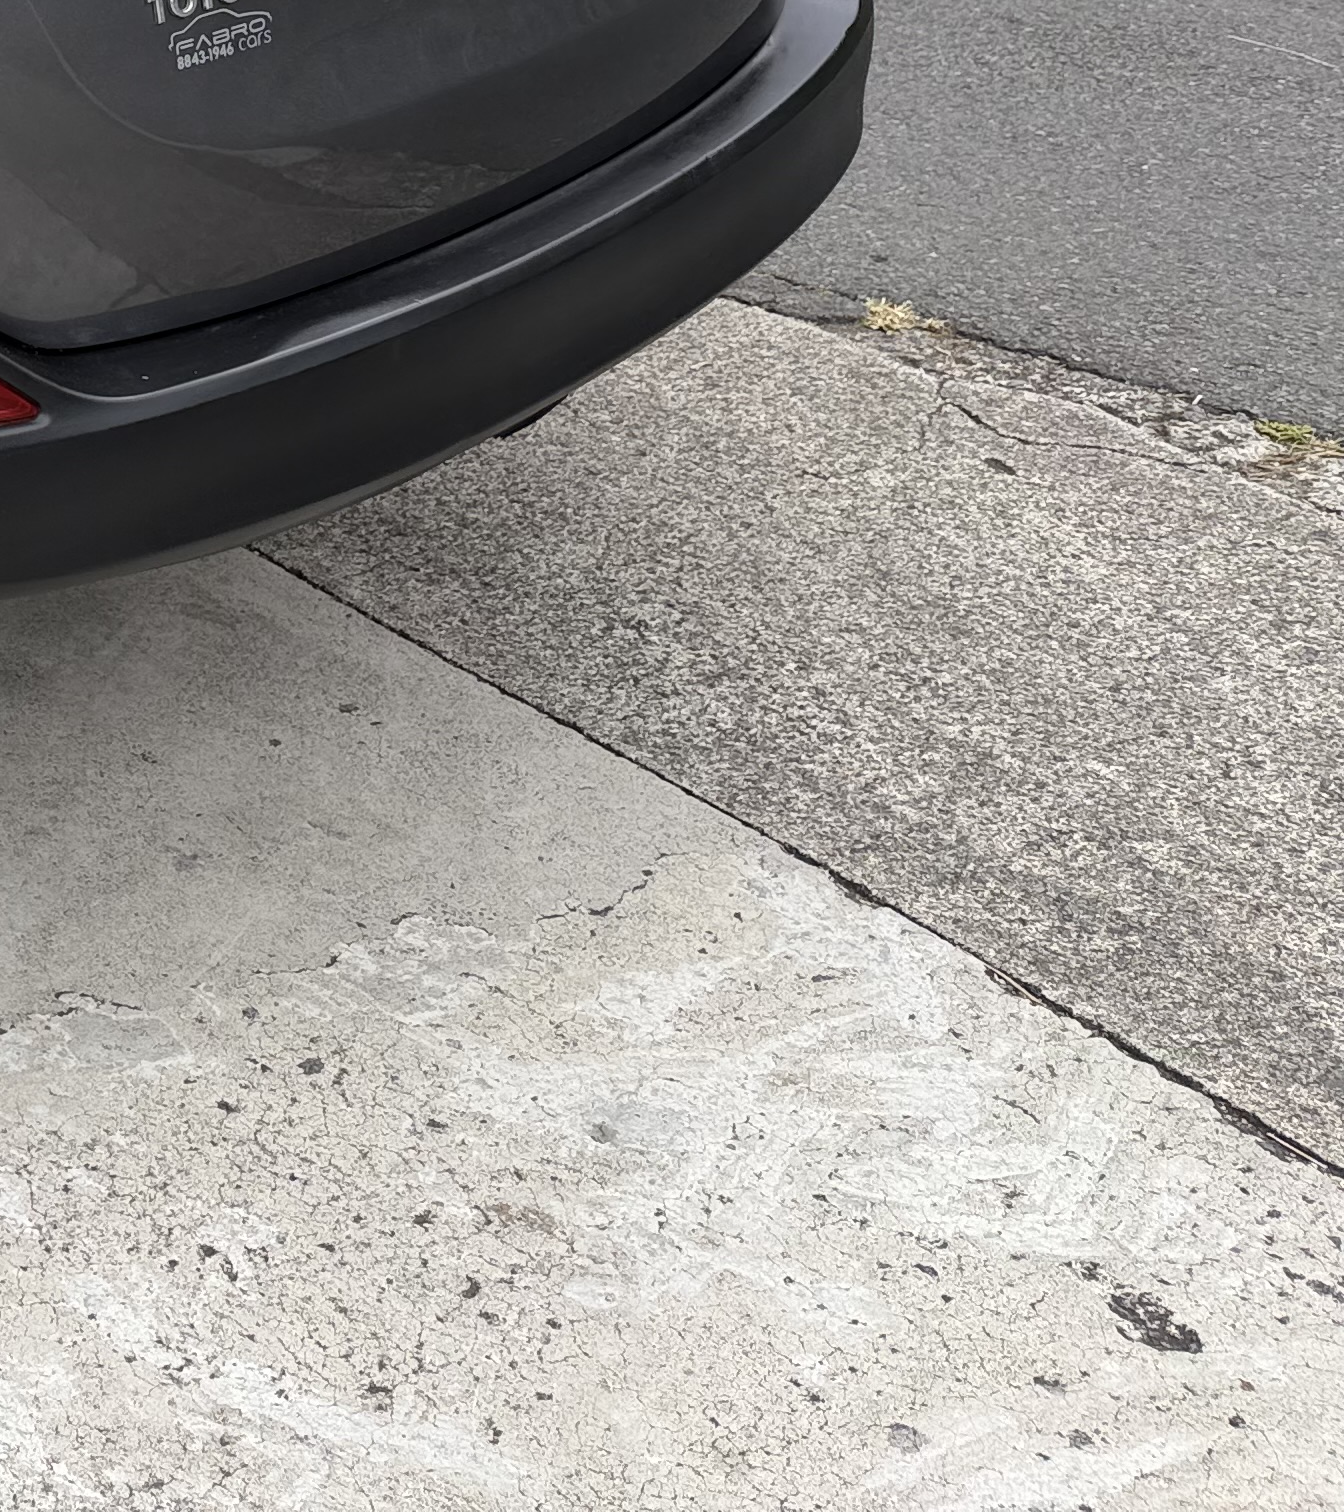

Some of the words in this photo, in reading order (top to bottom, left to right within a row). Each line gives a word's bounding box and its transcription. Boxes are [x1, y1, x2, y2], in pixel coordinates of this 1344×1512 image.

[175, 17, 266, 55] FABRO
[238, 29, 273, 52] cars
[176, 42, 235, 71] 8843-1946
